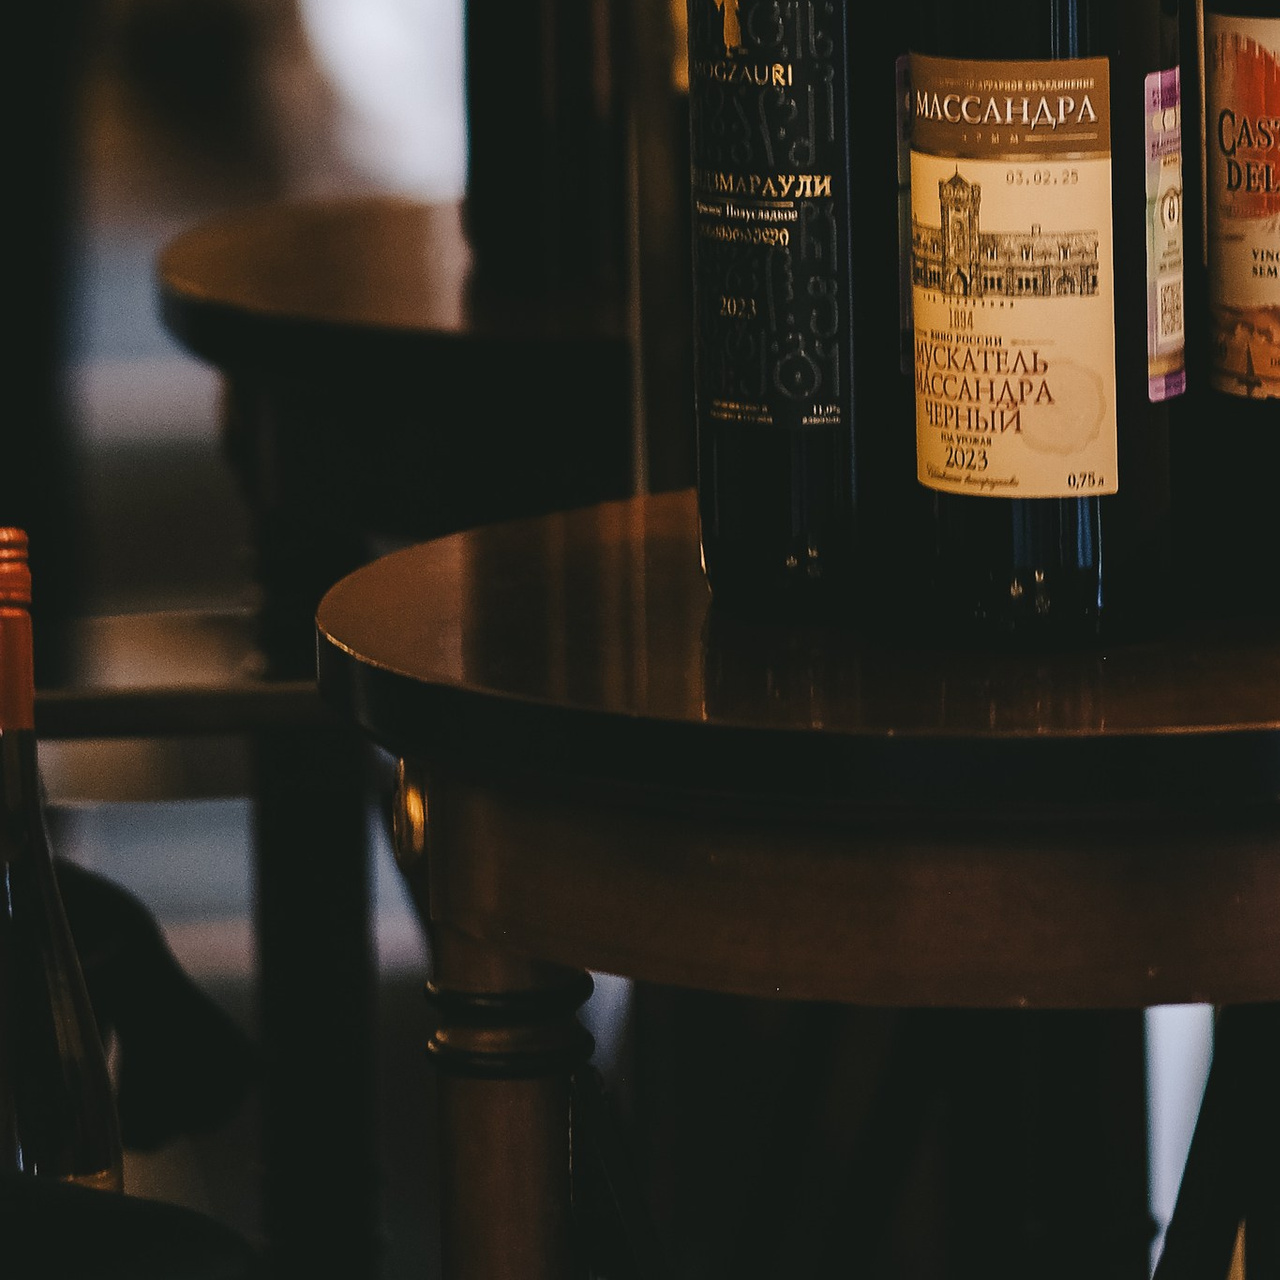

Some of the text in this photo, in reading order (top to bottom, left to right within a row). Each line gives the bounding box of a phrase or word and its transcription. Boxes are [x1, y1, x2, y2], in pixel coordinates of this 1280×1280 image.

[916, 90, 1098, 130] МАССАНДРА
[1226, 158, 1280, 192] DEL
[720, 295, 757, 320] 2023
[925, 400, 1023, 434] ЧЕРНЫЙ
[945, 446, 989, 472] 2023
[1067, 471, 1096, 492] 0,75
